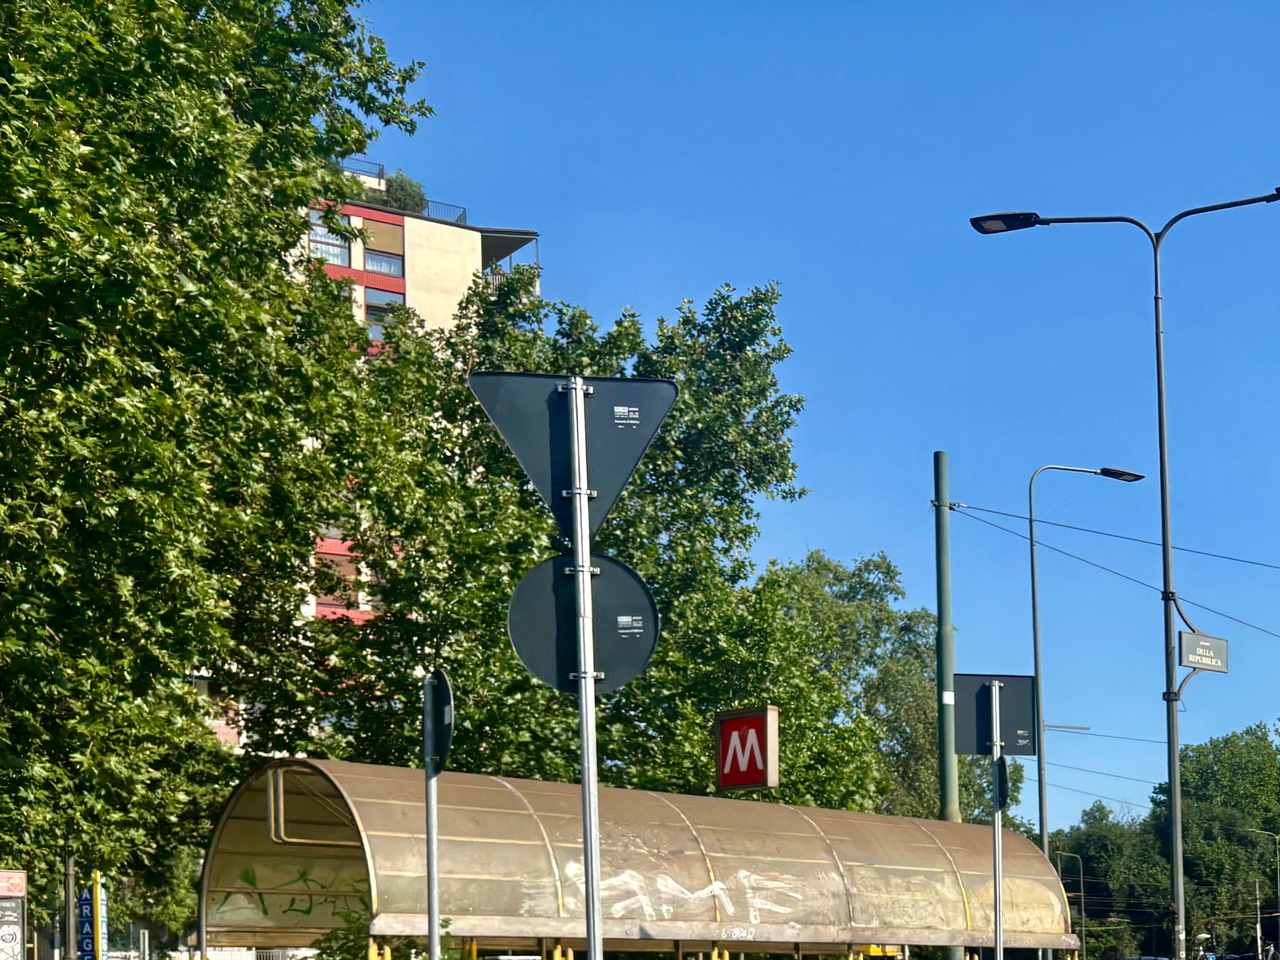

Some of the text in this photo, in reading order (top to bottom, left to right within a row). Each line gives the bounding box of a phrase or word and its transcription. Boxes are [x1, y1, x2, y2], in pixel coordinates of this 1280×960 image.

[1197, 647, 1214, 657] DELLA
[1189, 654, 1222, 667] REPUBBLICA
[723, 728, 764, 774] M
